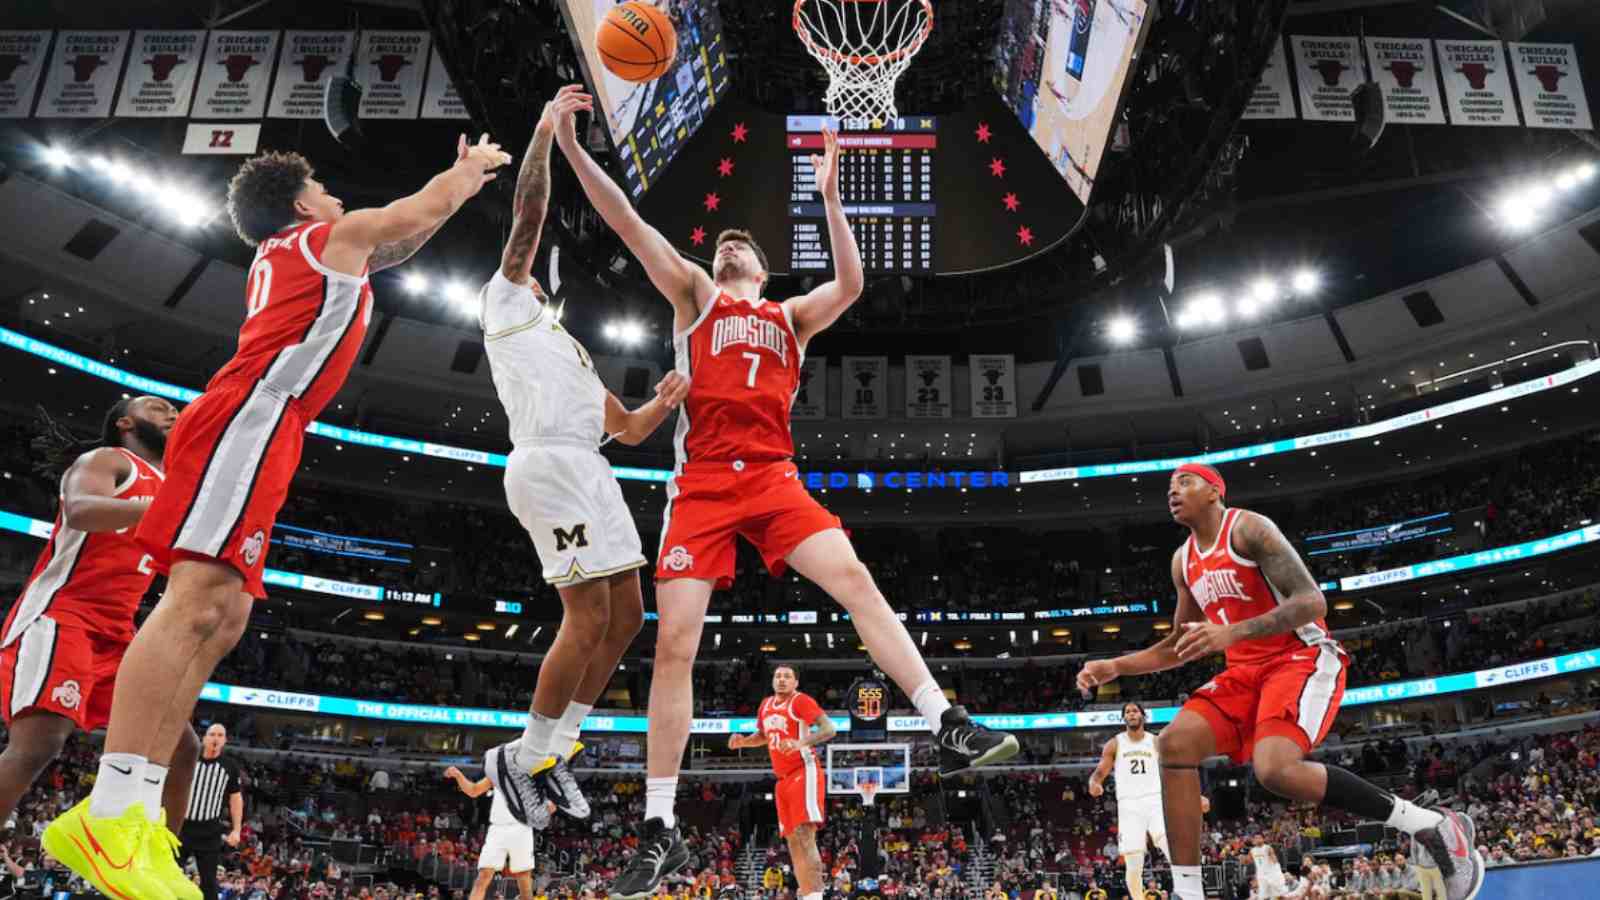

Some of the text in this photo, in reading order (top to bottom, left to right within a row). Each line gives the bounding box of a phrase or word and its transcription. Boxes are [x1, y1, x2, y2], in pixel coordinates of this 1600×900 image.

[66, 35, 119, 44] CHICAGO
[143, 34, 197, 44] CHICAGO
[217, 35, 270, 44] CHICAGO
[293, 35, 345, 44] CHICAGO
[369, 35, 421, 44] CHICAGO
[1301, 41, 1351, 49] CHICAGO
[1374, 41, 1423, 50] CHICAGO
[73, 46, 110, 54] BULLS
[149, 45, 187, 53] BULLS
[224, 45, 261, 53] BULLS
[300, 45, 336, 53] BULLS
[376, 45, 413, 54] BULLS
[1445, 44, 1495, 53] CHICAGO
[1518, 46, 1568, 55] CHICAGO
[1455, 54, 1490, 62] BULLS
[1527, 56, 1564, 64] BULLS
[209, 130, 235, 147] 72
[249, 259, 272, 319] 0
[711, 314, 789, 368] OHIO STATE
[31, 341, 84, 369] OFFICIAL
[742, 351, 760, 388] 7
[855, 388, 874, 404] 10
[917, 387, 940, 403] 23
[983, 385, 1004, 402] 33
[1315, 430, 1352, 444] CLIFFS
[447, 449, 484, 461] CLIFFS
[883, 471, 1009, 489] CENTER
[552, 523, 589, 551] M
[1369, 569, 1409, 585] CLIFFS
[331, 582, 432, 604] CLIFFS 11:12 AM
[732, 614, 754, 622] FOULS
[969, 613, 991, 622] FOULS
[1216, 607, 1230, 625] 1
[1504, 662, 1551, 680] CLIFFS
[1387, 683, 1406, 698] OF
[266, 693, 316, 707] CLIFFS
[355, 703, 384, 716] THE
[387, 705, 450, 721] OFFICIAL
[455, 709, 497, 726] STEEL
[857, 699, 881, 717] 30
[690, 718, 724, 730] LIFFS
[768, 732, 782, 750] 21
[1129, 759, 1147, 775] 21
